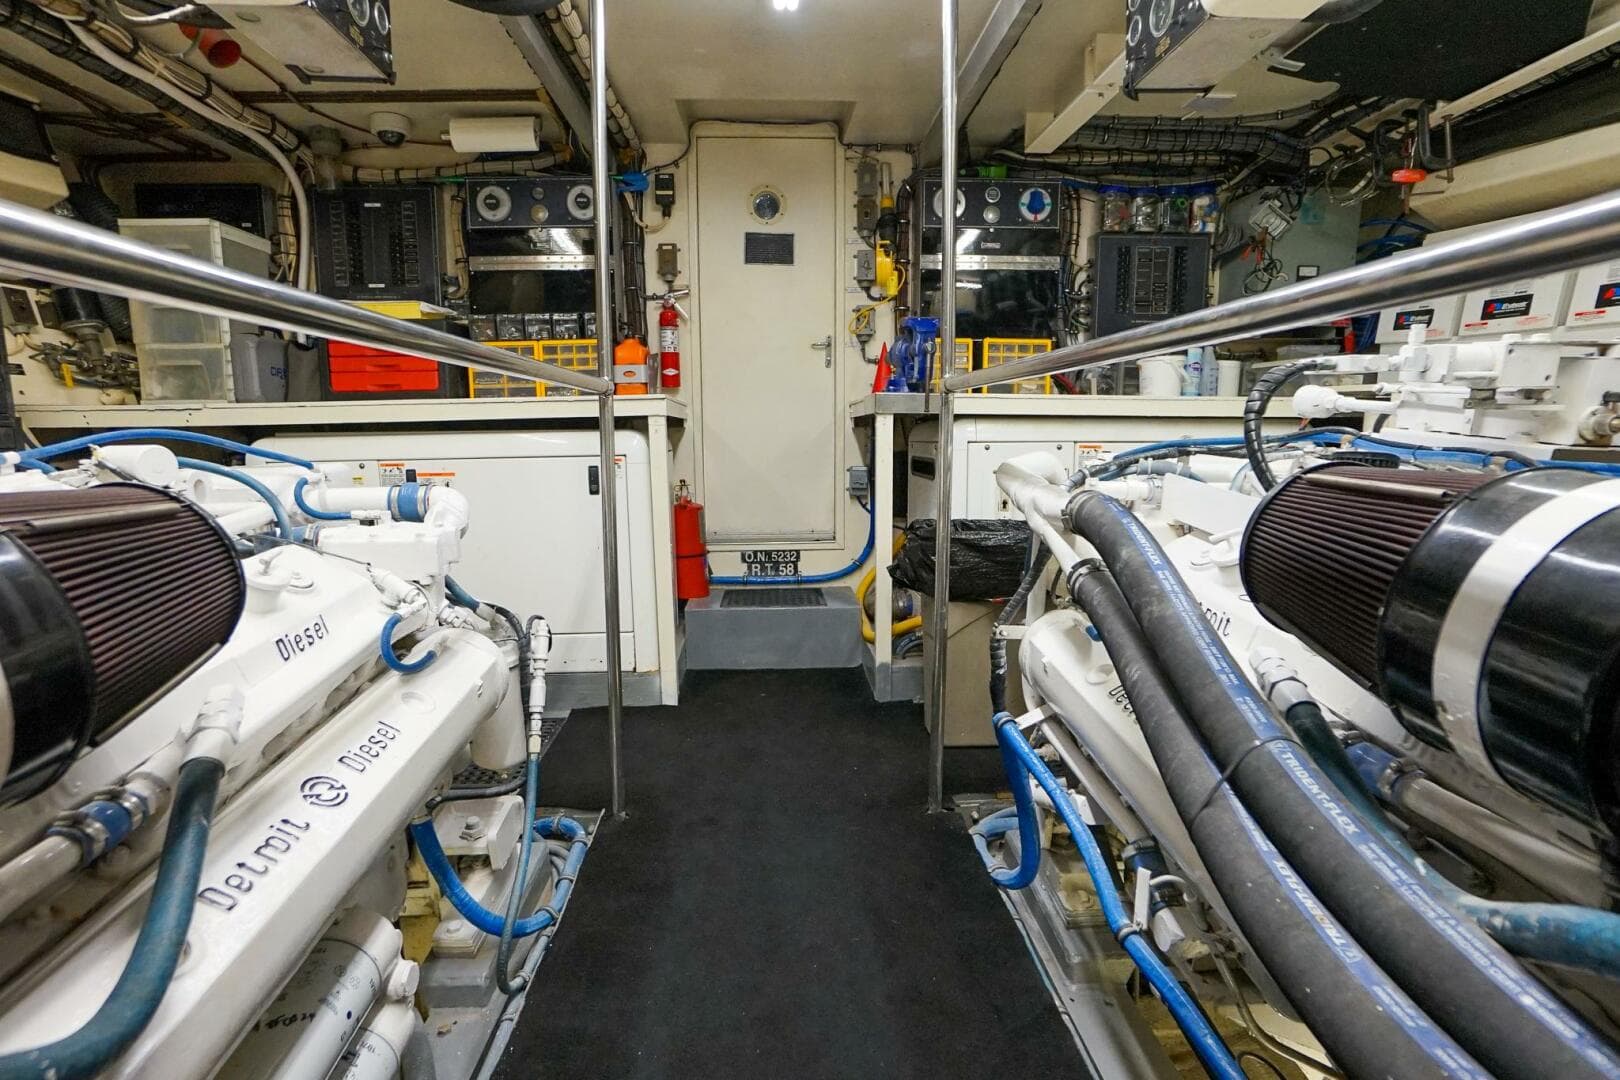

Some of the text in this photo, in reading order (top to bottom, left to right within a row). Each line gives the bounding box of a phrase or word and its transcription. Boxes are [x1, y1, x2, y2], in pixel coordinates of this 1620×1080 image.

[751, 563, 795, 576] R.T. 58
[771, 551, 797, 562] 5232
[275, 614, 329, 662] Diesel
[198, 818, 310, 911] Detroit
[337, 720, 401, 775] Diesel
[1281, 751, 1361, 834] TRIDENT-FLEX
[1272, 858, 1348, 947] TRIDENT-FLEX
